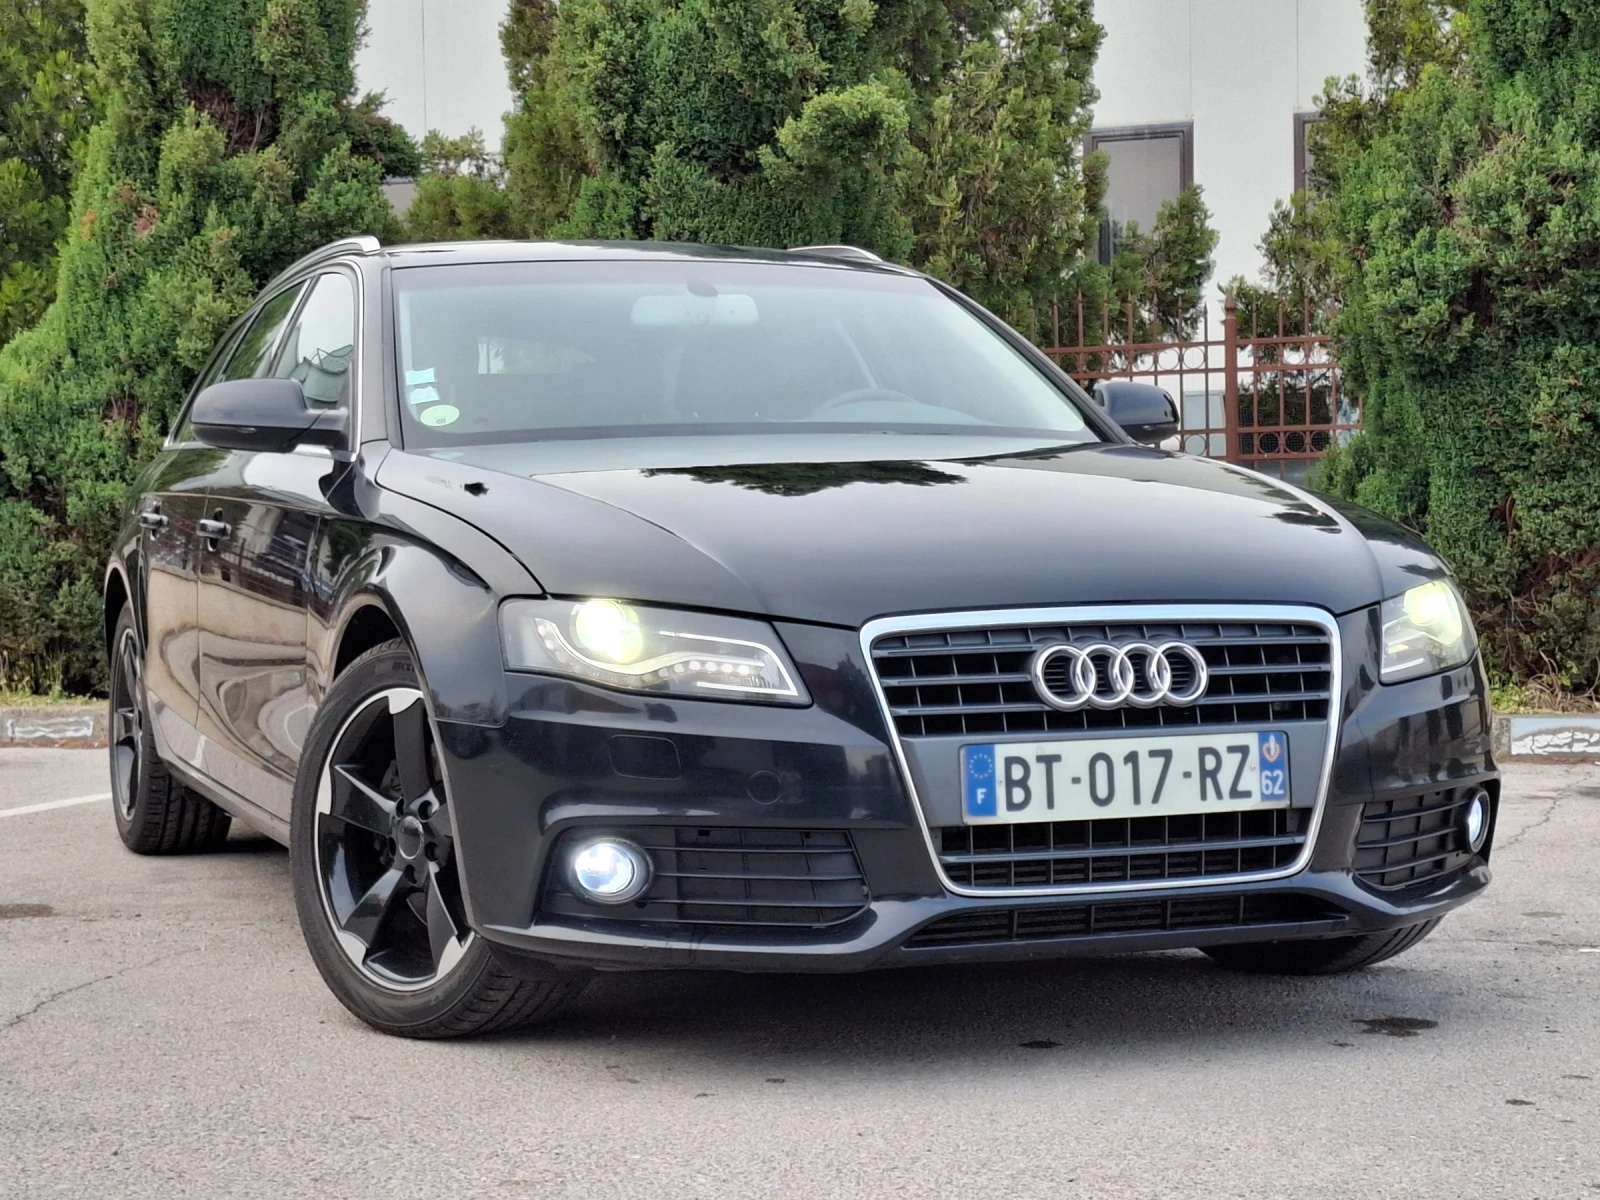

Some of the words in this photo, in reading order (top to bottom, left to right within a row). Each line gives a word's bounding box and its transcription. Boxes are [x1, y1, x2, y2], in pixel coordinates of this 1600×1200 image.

[1004, 745, 1253, 811] BT-017-RZ
[1261, 770, 1285, 796] 62
[976, 788, 988, 805] F
